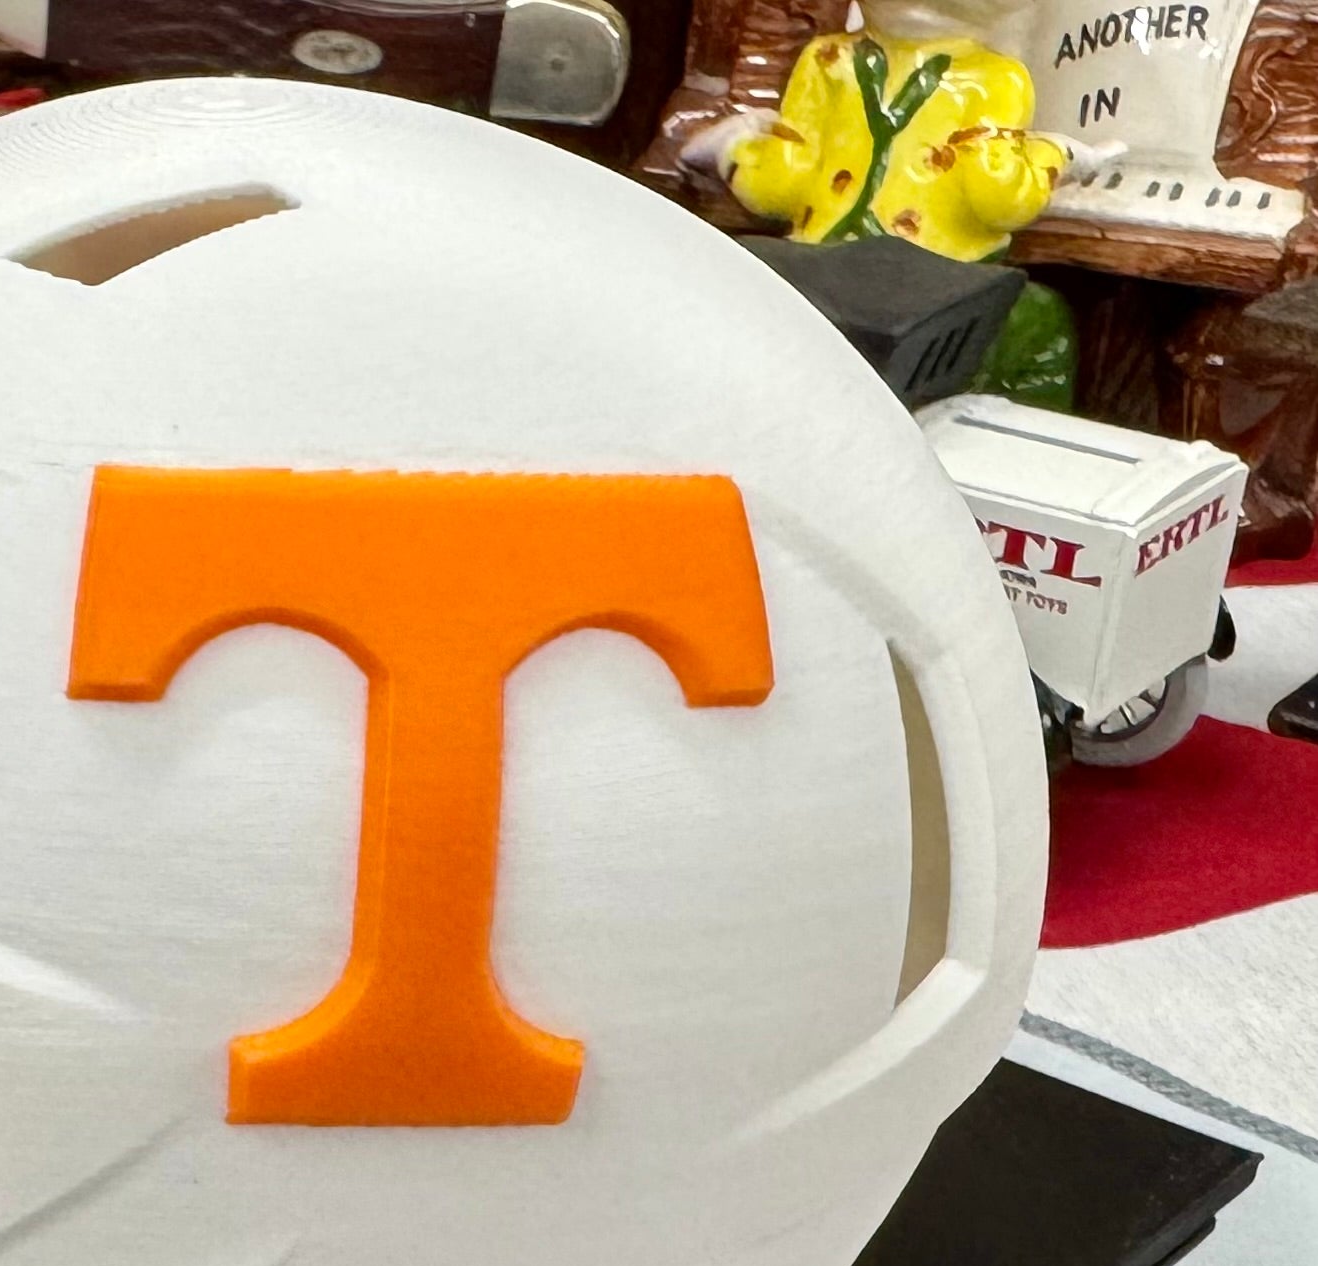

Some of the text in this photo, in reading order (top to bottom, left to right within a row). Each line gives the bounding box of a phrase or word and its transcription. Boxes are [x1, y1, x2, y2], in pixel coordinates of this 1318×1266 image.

[1054, 4, 1210, 69] ANOTHER
[1079, 86, 1121, 128] IN
[973, 516, 1102, 588] TL
[1134, 494, 1230, 578] ERTL
[65, 463, 775, 1128] T
